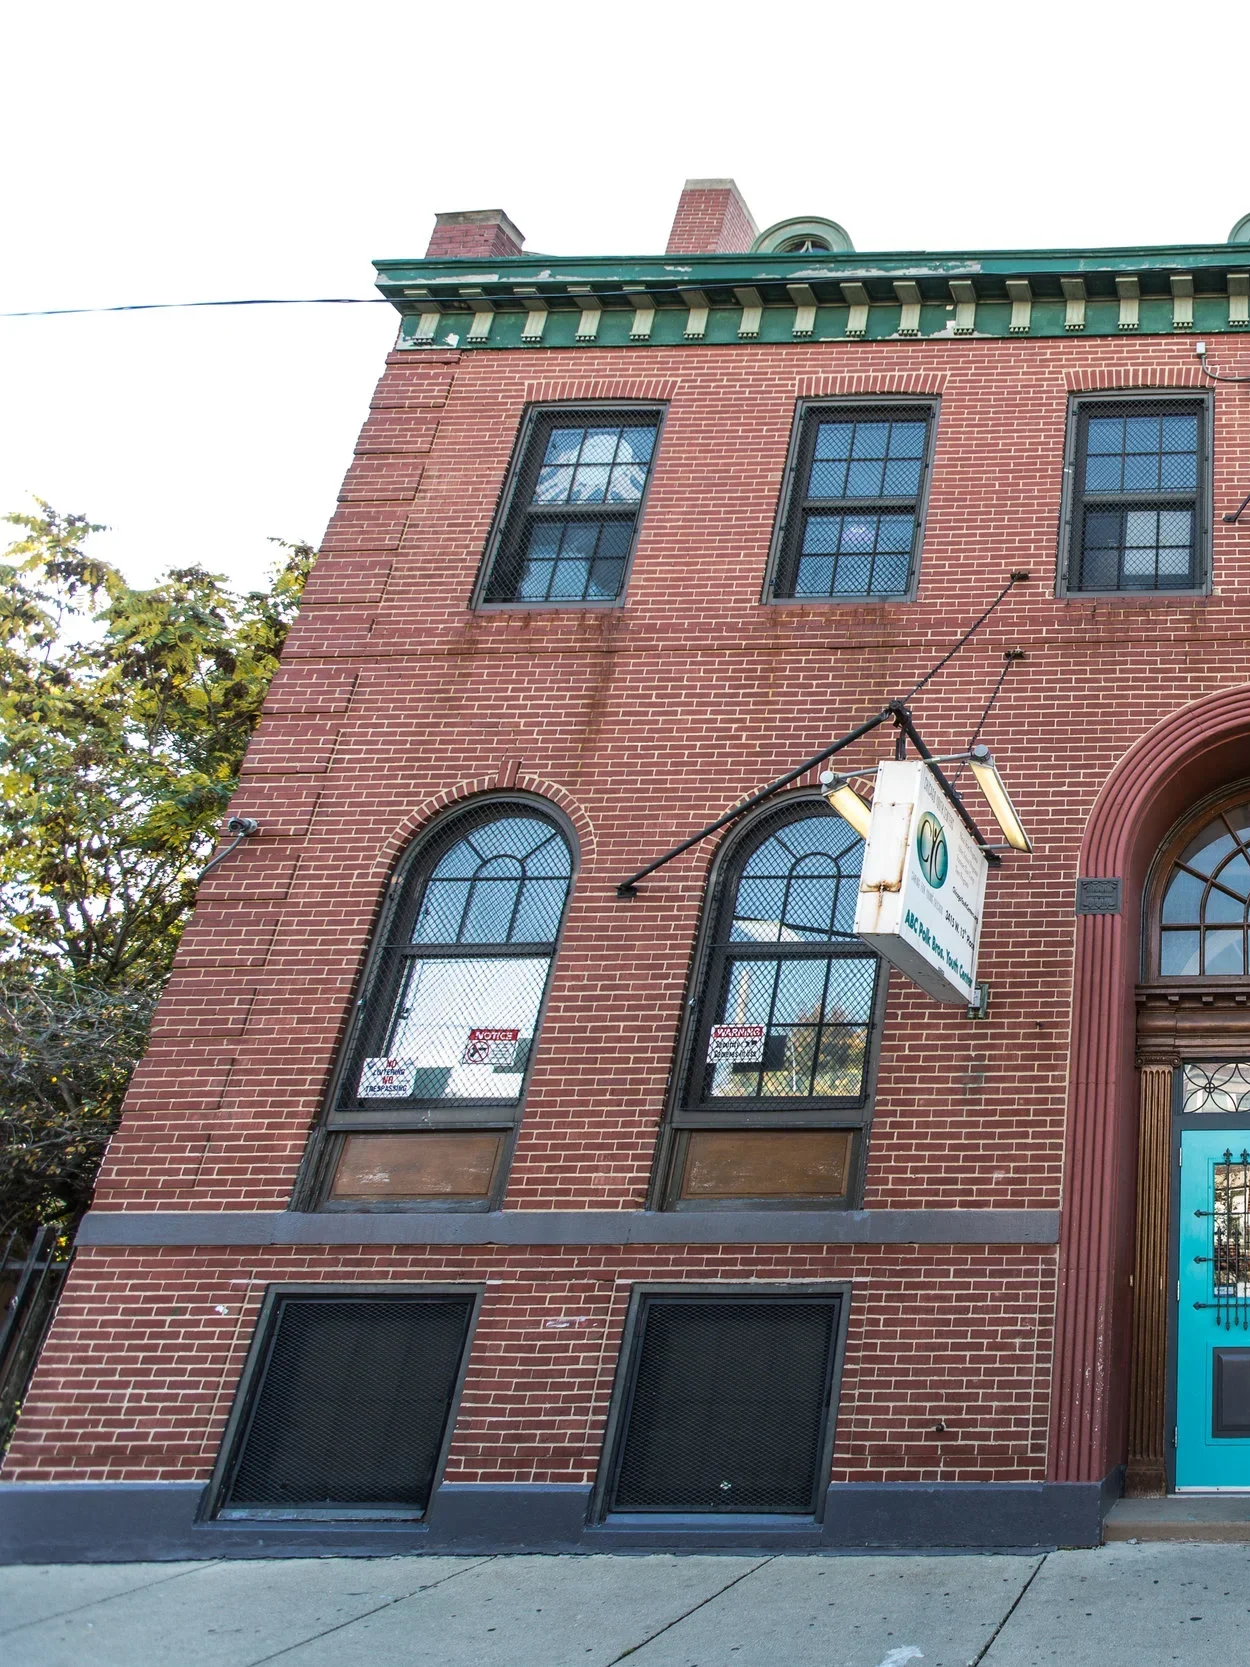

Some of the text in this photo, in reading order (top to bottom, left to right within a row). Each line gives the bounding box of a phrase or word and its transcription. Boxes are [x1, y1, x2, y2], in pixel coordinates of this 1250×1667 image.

[905, 909, 917, 934] ABC
[918, 922, 931, 947] Polk
[932, 936, 945, 960] Bros.
[946, 949, 959, 975] Youth
[959, 964, 973, 988] Center
[717, 1028, 760, 1036] WARNING
[387, 1060, 398, 1068] NO
[382, 1076, 393, 1084] NO
